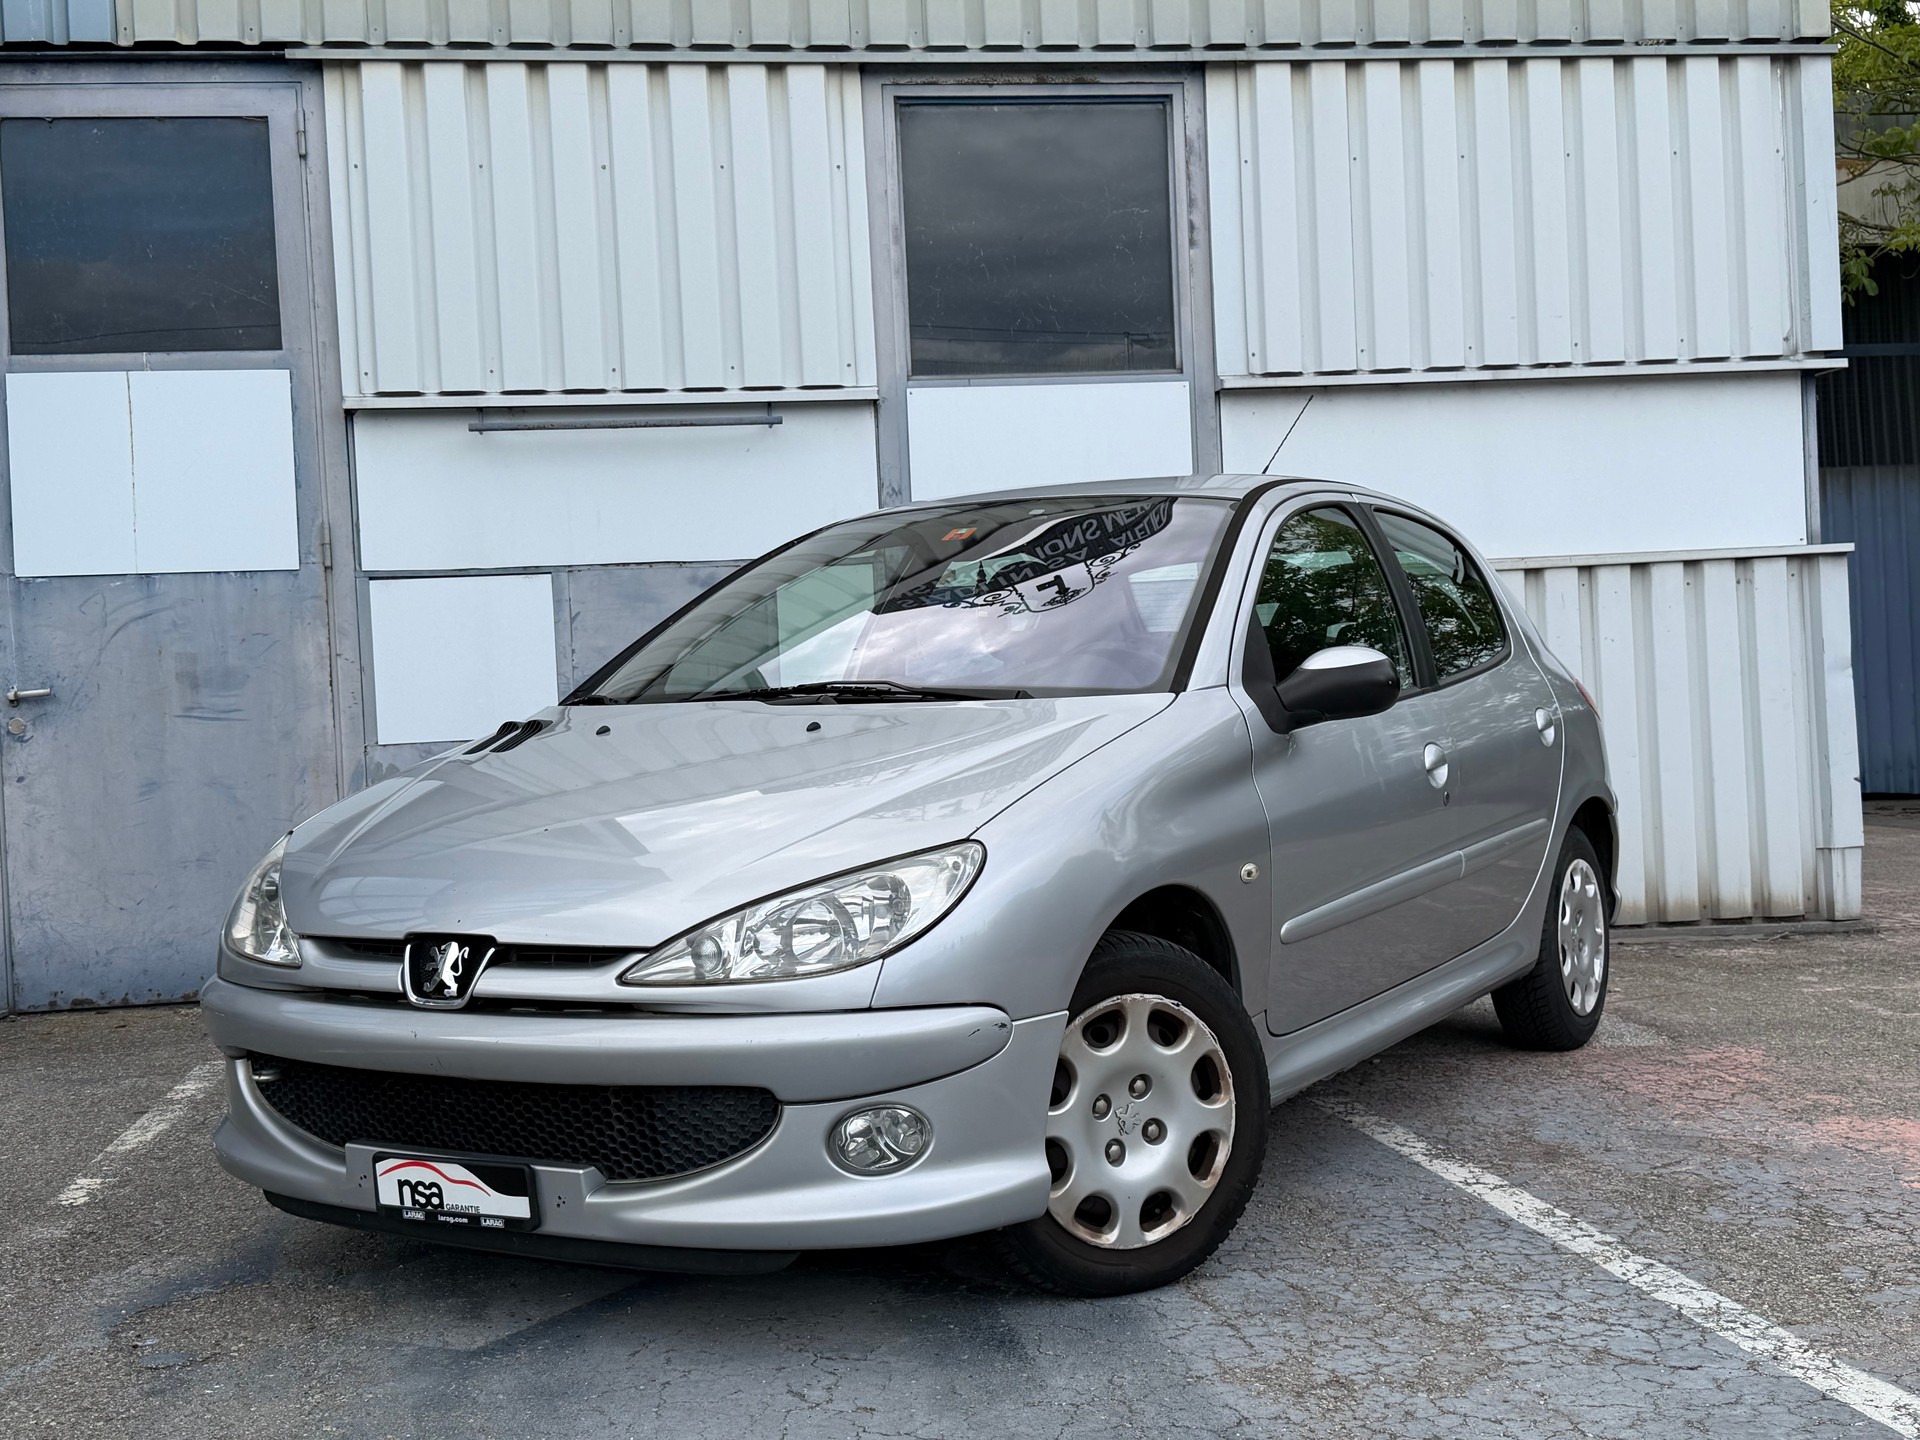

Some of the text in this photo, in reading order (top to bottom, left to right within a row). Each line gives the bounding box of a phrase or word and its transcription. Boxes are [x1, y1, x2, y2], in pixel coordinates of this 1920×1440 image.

[397, 1179, 481, 1213] nsa GARANTIE
[403, 1210, 425, 1220] LARAG
[438, 1214, 468, 1224] larag.com
